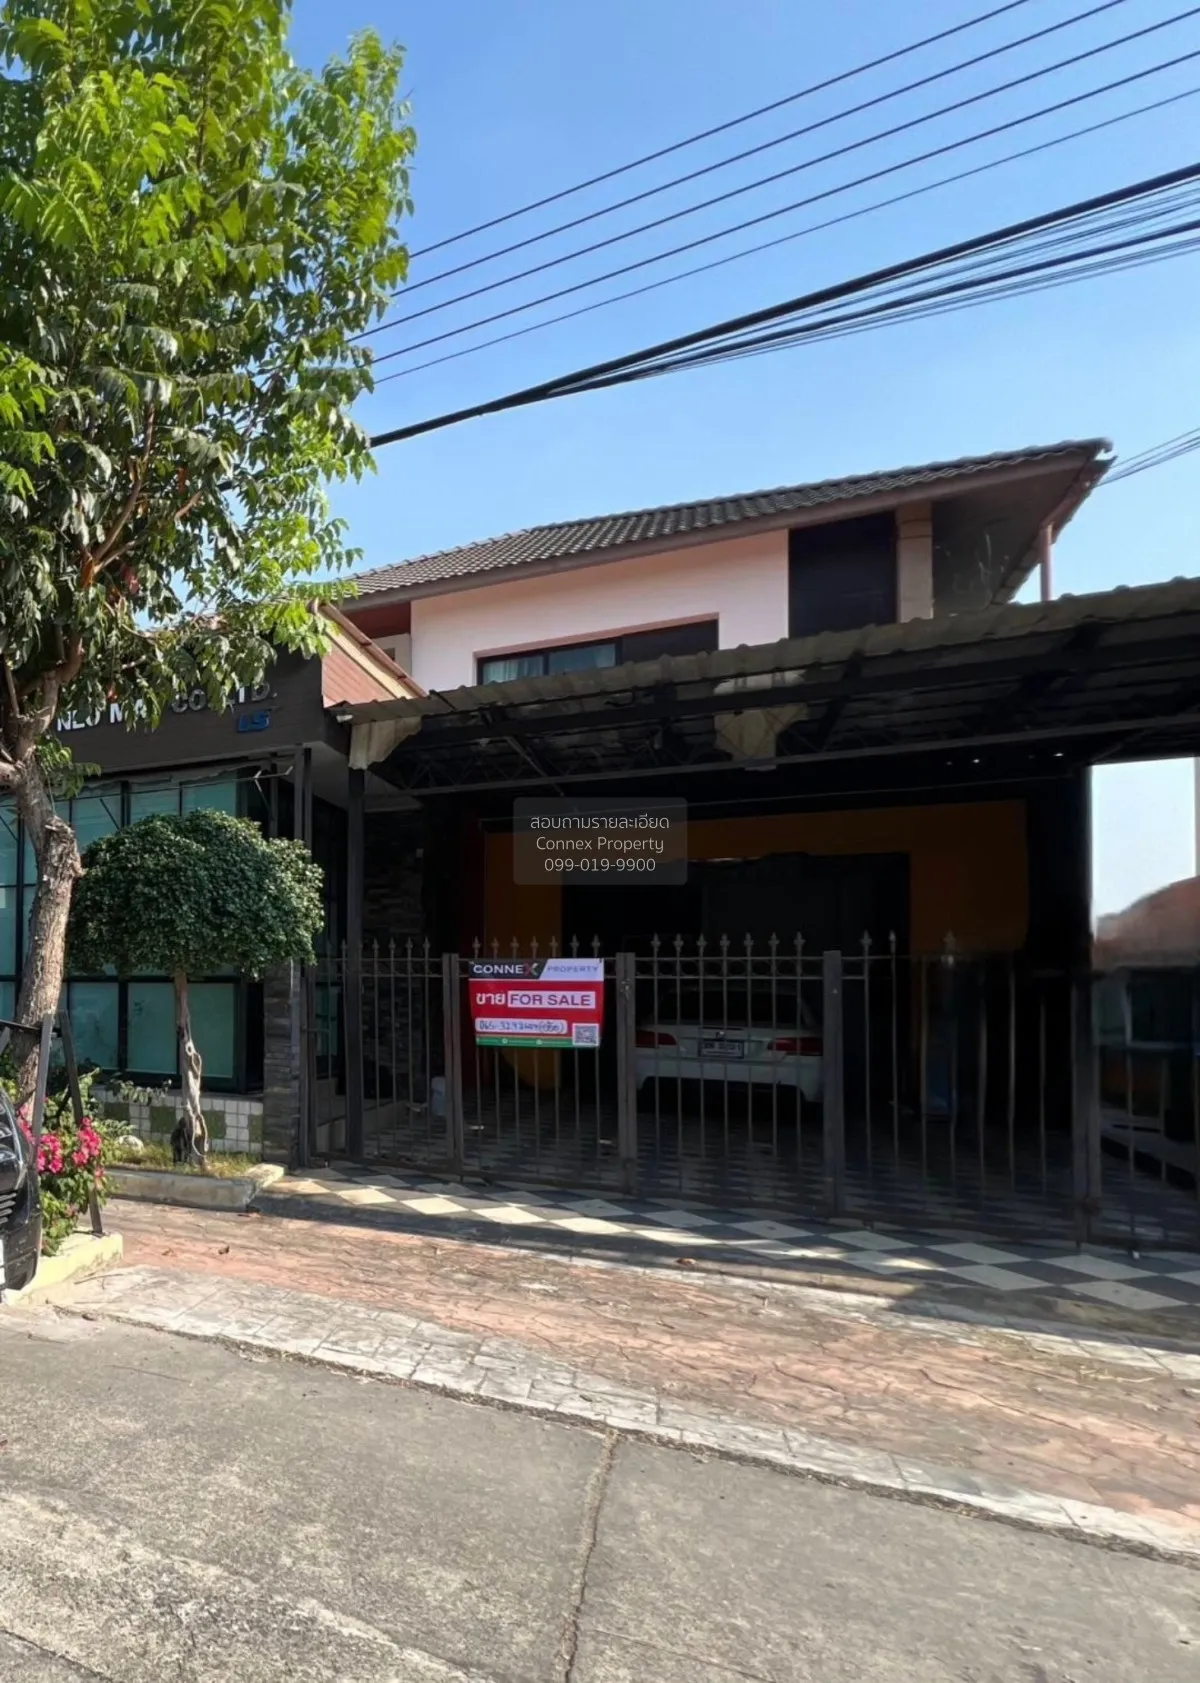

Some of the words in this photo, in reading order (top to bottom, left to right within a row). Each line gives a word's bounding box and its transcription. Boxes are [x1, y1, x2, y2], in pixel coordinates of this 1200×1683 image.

[547, 964, 599, 973] PROPERTY
[476, 992, 505, 1005] ขาย
[510, 994, 543, 1006] FOR
[547, 994, 591, 1006] SALE
